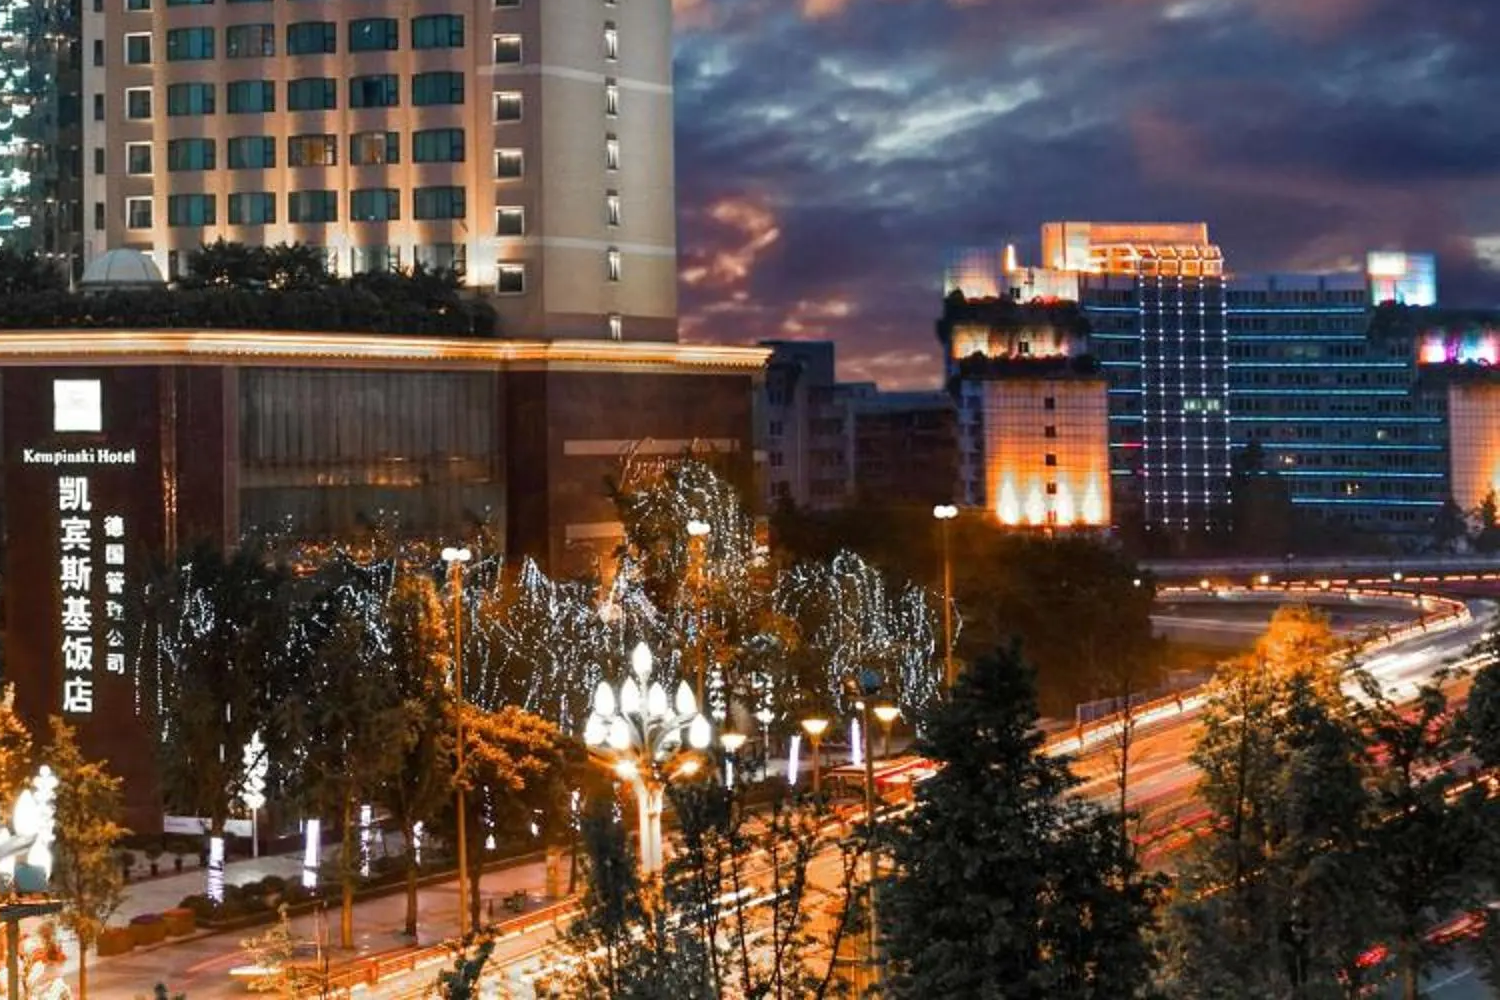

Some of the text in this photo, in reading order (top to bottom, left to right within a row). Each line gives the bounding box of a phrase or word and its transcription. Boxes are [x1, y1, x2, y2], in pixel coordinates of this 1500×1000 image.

[23, 448, 136, 466] Kempinski Hotel
[58, 476, 93, 714] 凯宾斯基饭店
